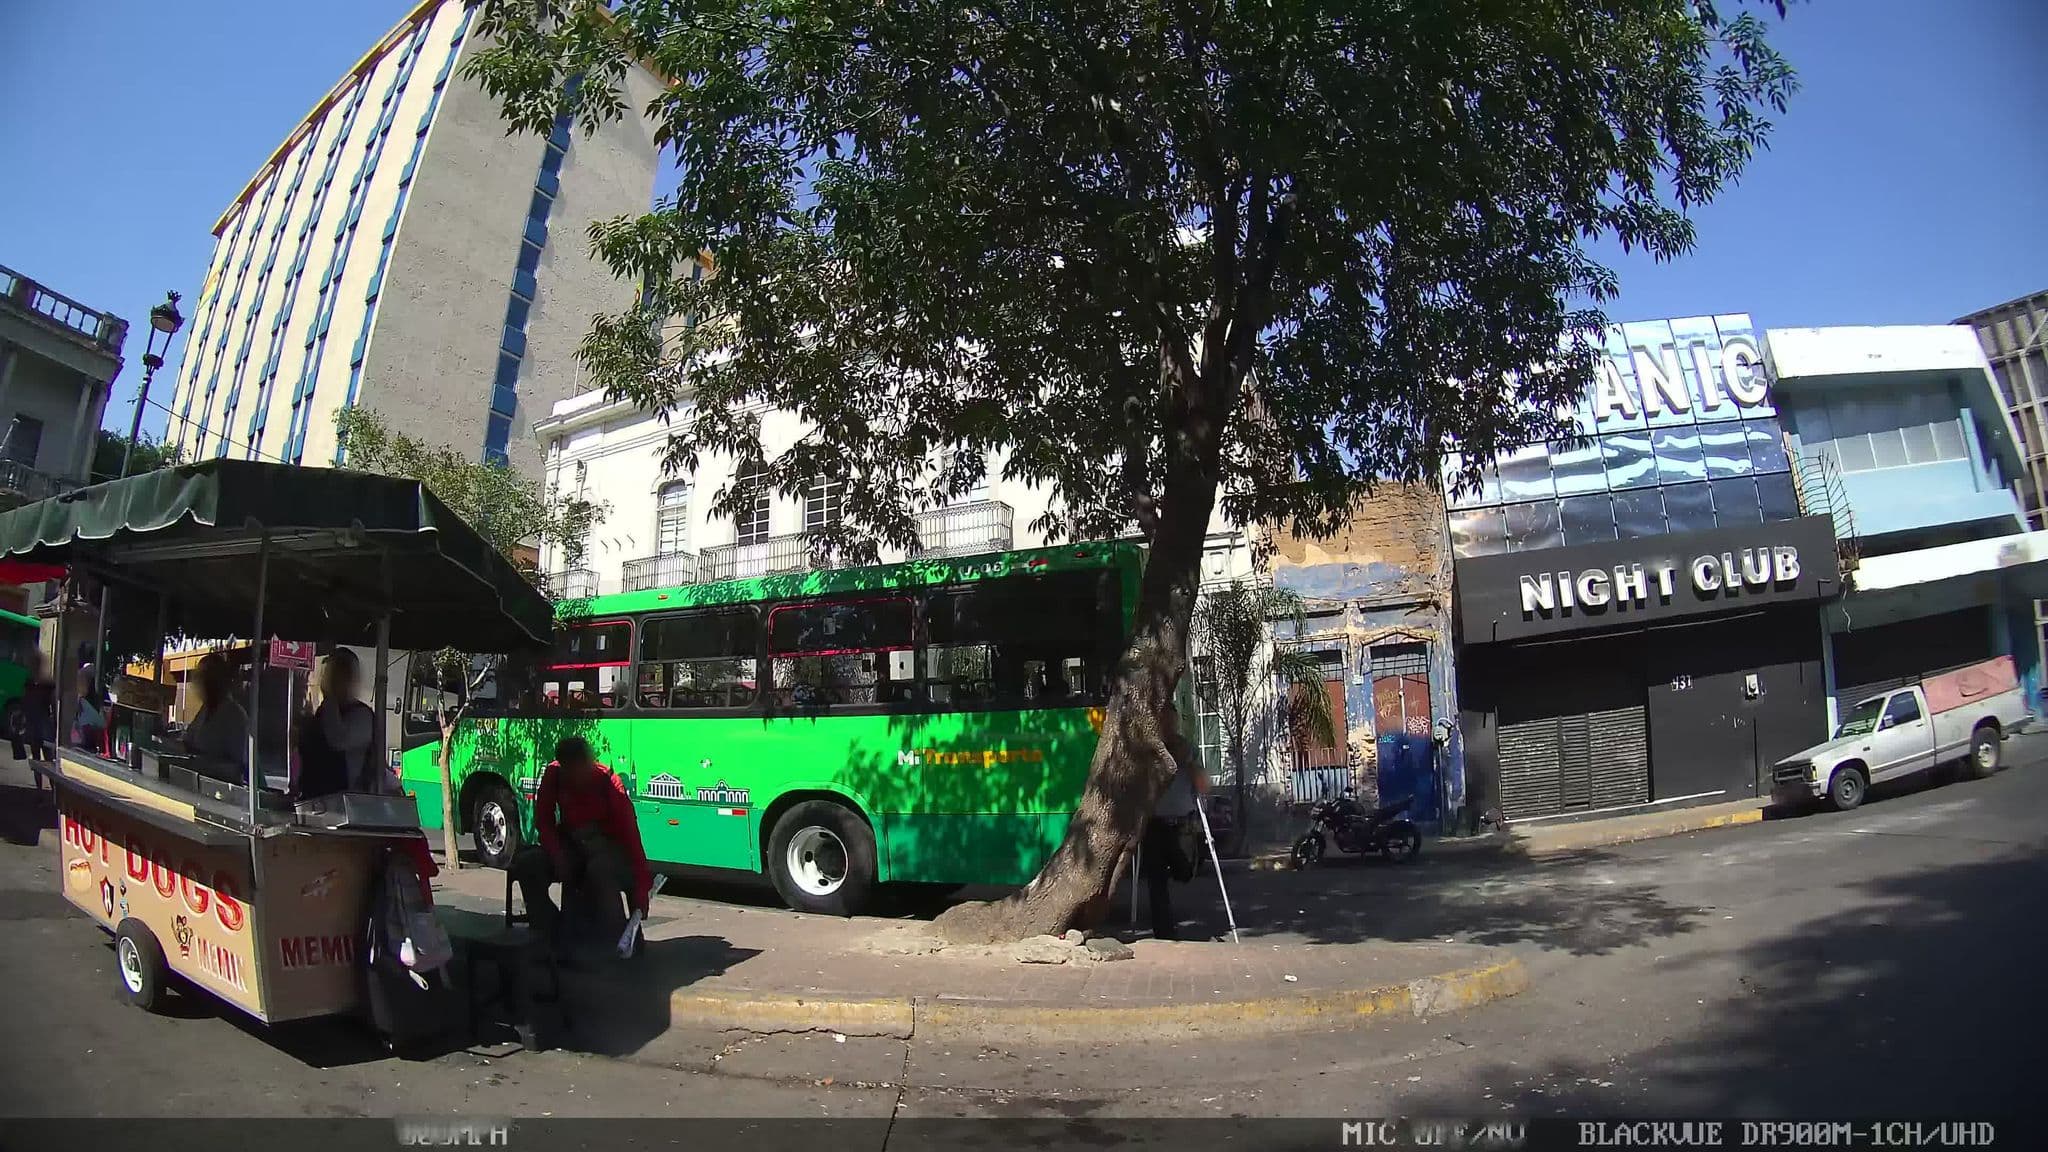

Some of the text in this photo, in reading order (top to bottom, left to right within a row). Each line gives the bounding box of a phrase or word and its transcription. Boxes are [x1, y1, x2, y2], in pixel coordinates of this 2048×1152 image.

[1530, 336, 1769, 423] ANIC
[1520, 546, 1800, 612] NIGHT CLUB
[897, 750, 920, 766] Mi
[124, 834, 245, 933] DOGS
[279, 935, 357, 970] MEMI
